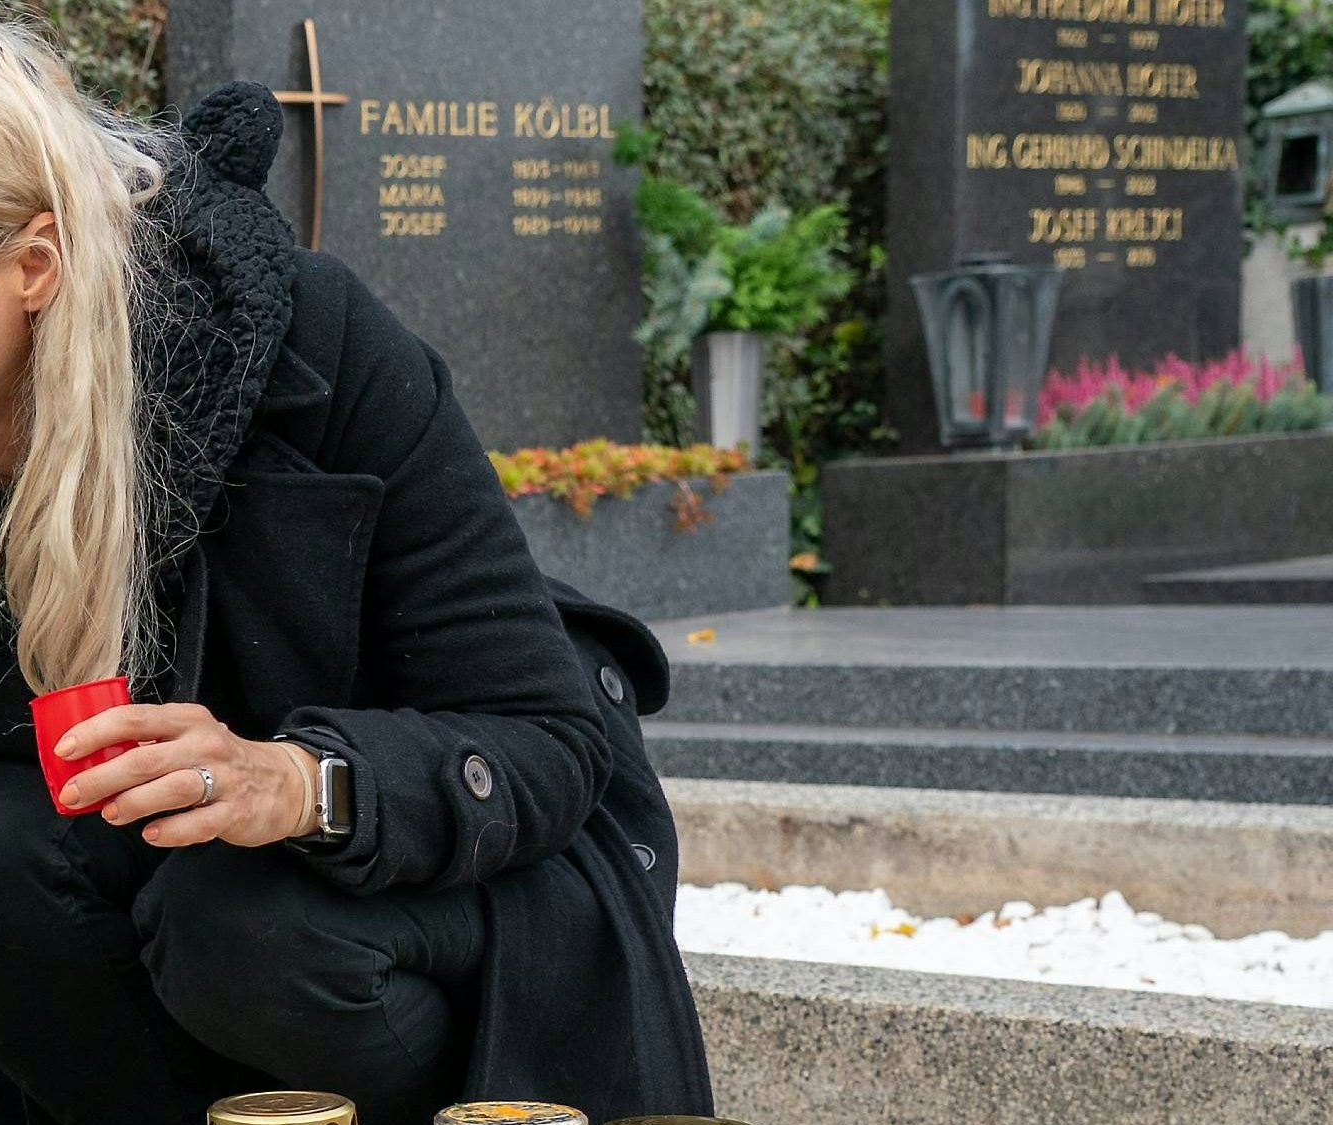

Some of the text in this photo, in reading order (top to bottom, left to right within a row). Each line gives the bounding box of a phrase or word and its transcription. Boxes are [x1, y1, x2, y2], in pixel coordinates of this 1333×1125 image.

[1016, 58, 1124, 96] JOHANNA
[360, 95, 616, 139] FAMILIE KÖLBL
[380, 154, 447, 178] JOSEF
[1013, 133, 1110, 169] GERHARD
[379, 183, 444, 207] MARIA
[380, 211, 447, 236] JOSEF
[1028, 208, 1099, 243] JOSEF
